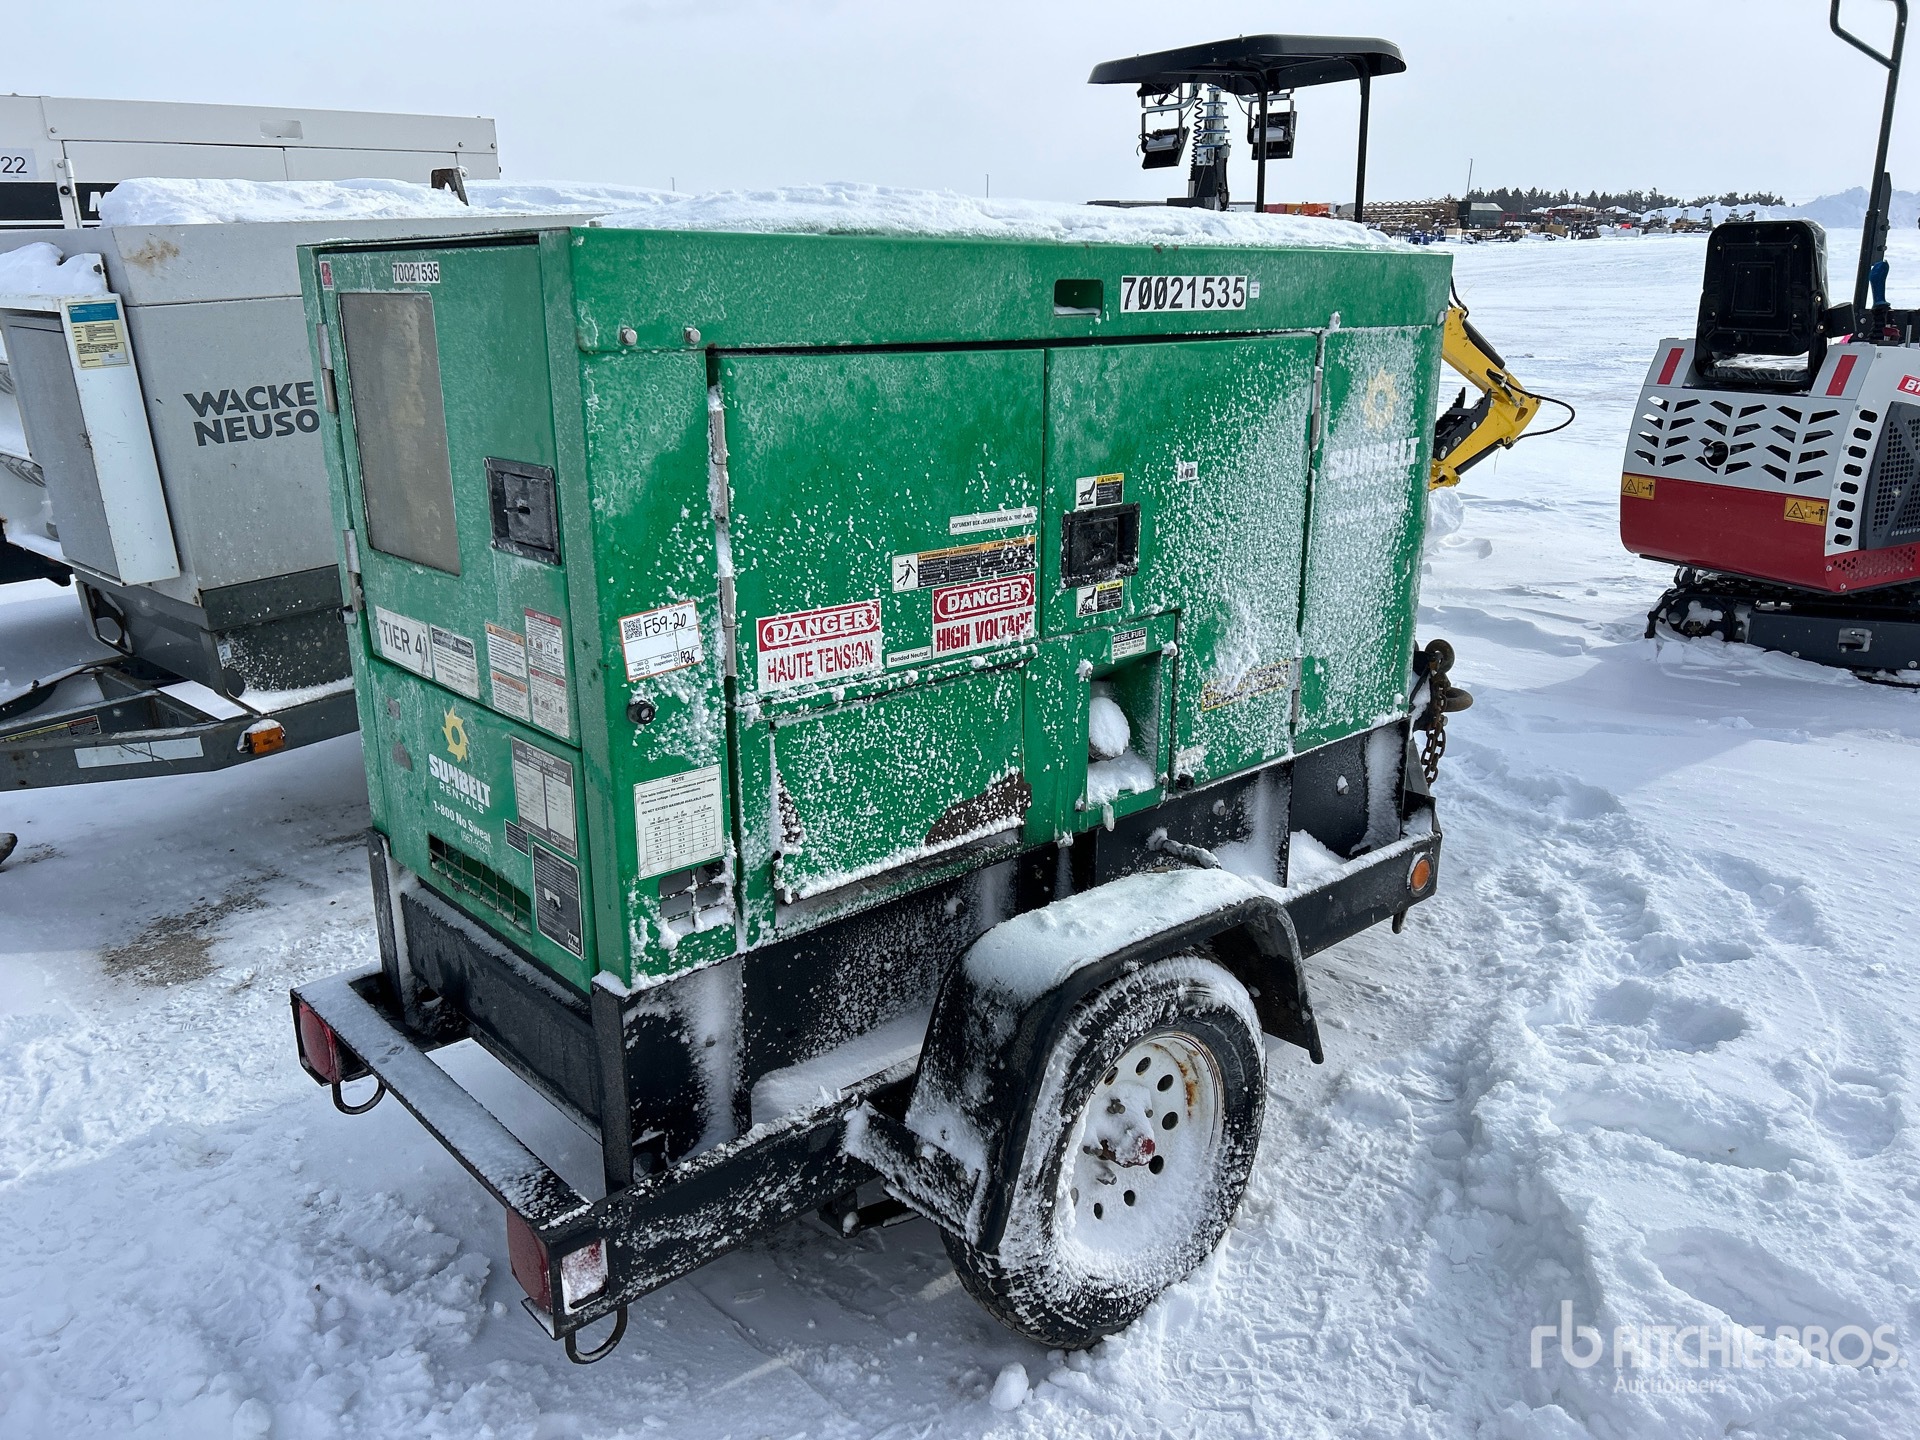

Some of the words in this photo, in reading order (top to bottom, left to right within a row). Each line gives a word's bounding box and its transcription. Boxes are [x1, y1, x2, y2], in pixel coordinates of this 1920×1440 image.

[0, 156, 28, 174] 22
[392, 263, 440, 282] 70021535
[1122, 276, 1246, 310] 70021535
[947, 583, 1022, 613] DANGER
[380, 619, 411, 655] TIER
[643, 612, 687, 637] F59-20
[771, 609, 869, 642] DANGER
[936, 623, 970, 653] HIGH
[975, 611, 1033, 644] VOLTAGE
[1132, 630, 1145, 638] FUEL
[767, 650, 814, 683] HAUTE
[817, 639, 874, 673] TENSION
[890, 653, 910, 663] Bonded
[910, 650, 928, 659] Neutral
[428, 753, 491, 808] SUNBELT
[439, 781, 485, 815] RENTALS
[433, 800, 455, 822] 1-800
[455, 811, 467, 829] No
[467, 819, 492, 845] Sweat
